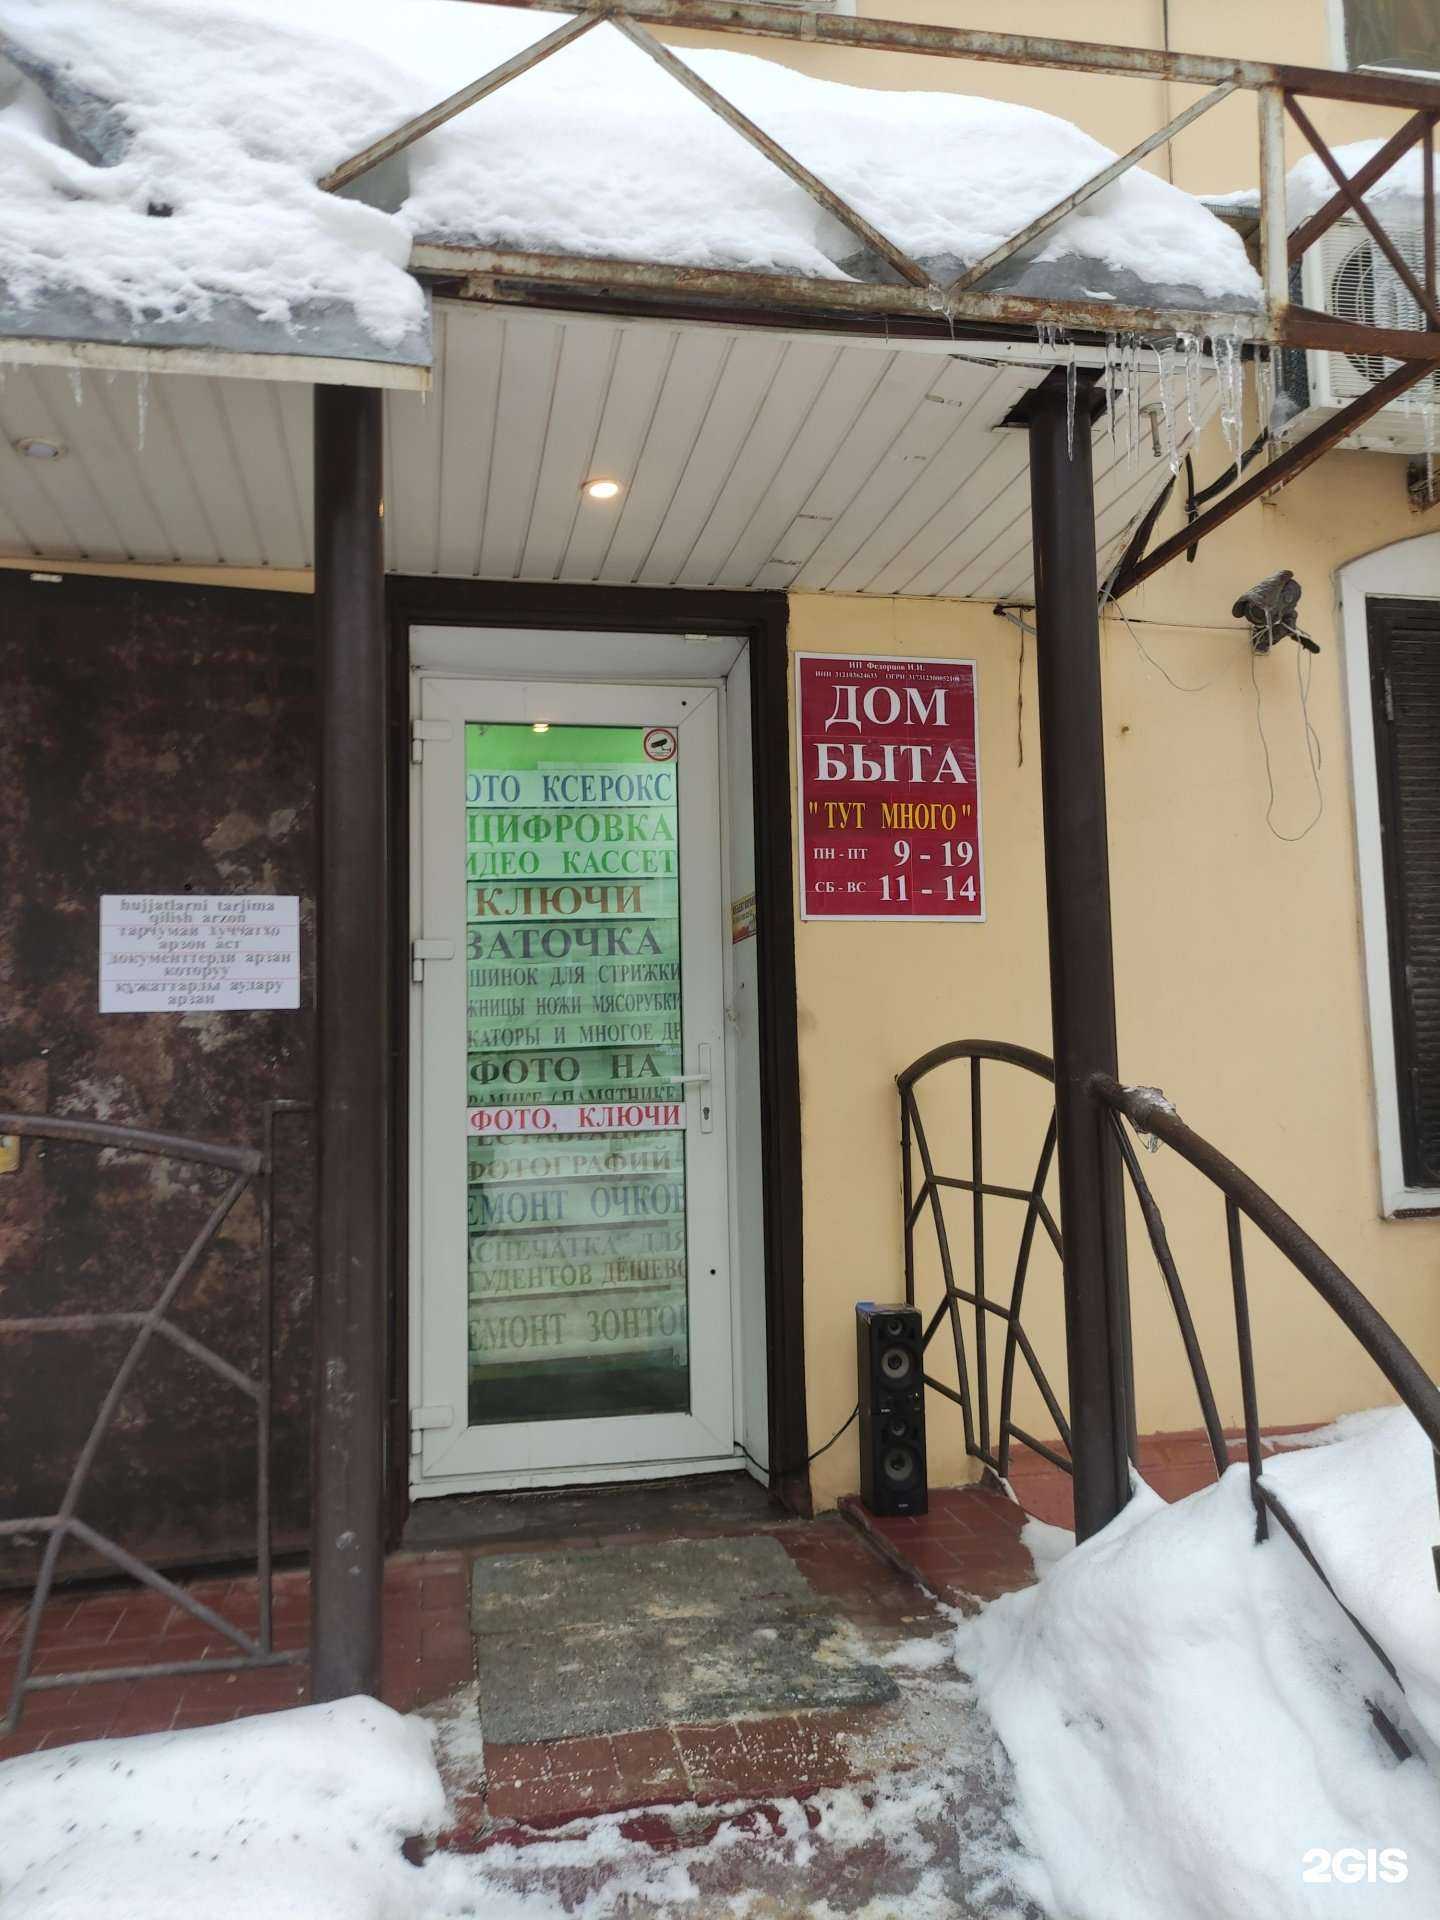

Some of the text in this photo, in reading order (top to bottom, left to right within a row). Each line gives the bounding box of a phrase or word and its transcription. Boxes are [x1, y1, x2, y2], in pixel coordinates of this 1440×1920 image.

[825, 685, 950, 734] ДОМ
[813, 743, 968, 783] БЫТА
[543, 773, 672, 802] КСЕРОКС
[468, 813, 674, 846] ЦИФРОВКА
[562, 849, 675, 874] КАССЕТ
[813, 848, 835, 860] ПН
[848, 848, 868, 860] ПТ
[894, 840, 911, 867] 9
[941, 841, 973, 867] 19
[475, 885, 642, 916] КЛЮЧИ
[815, 882, 834, 893] СБ
[847, 882, 866, 893] ВС
[879, 875, 909, 901] 11
[943, 875, 976, 902] 14
[217, 900, 275, 913] tarjima
[467, 926, 663, 960] ЗАТОЧКА
[550, 965, 585, 986] ДЛЯ
[598, 964, 681, 984] СТРИЖКИ
[536, 995, 581, 1016] НОЖИ
[554, 1026, 566, 1044] И
[580, 1022, 653, 1043] МНОГОЕ
[470, 1053, 661, 1085] ФОТО НА
[470, 1104, 680, 1131] ФОТО, КЛЮЧИ
